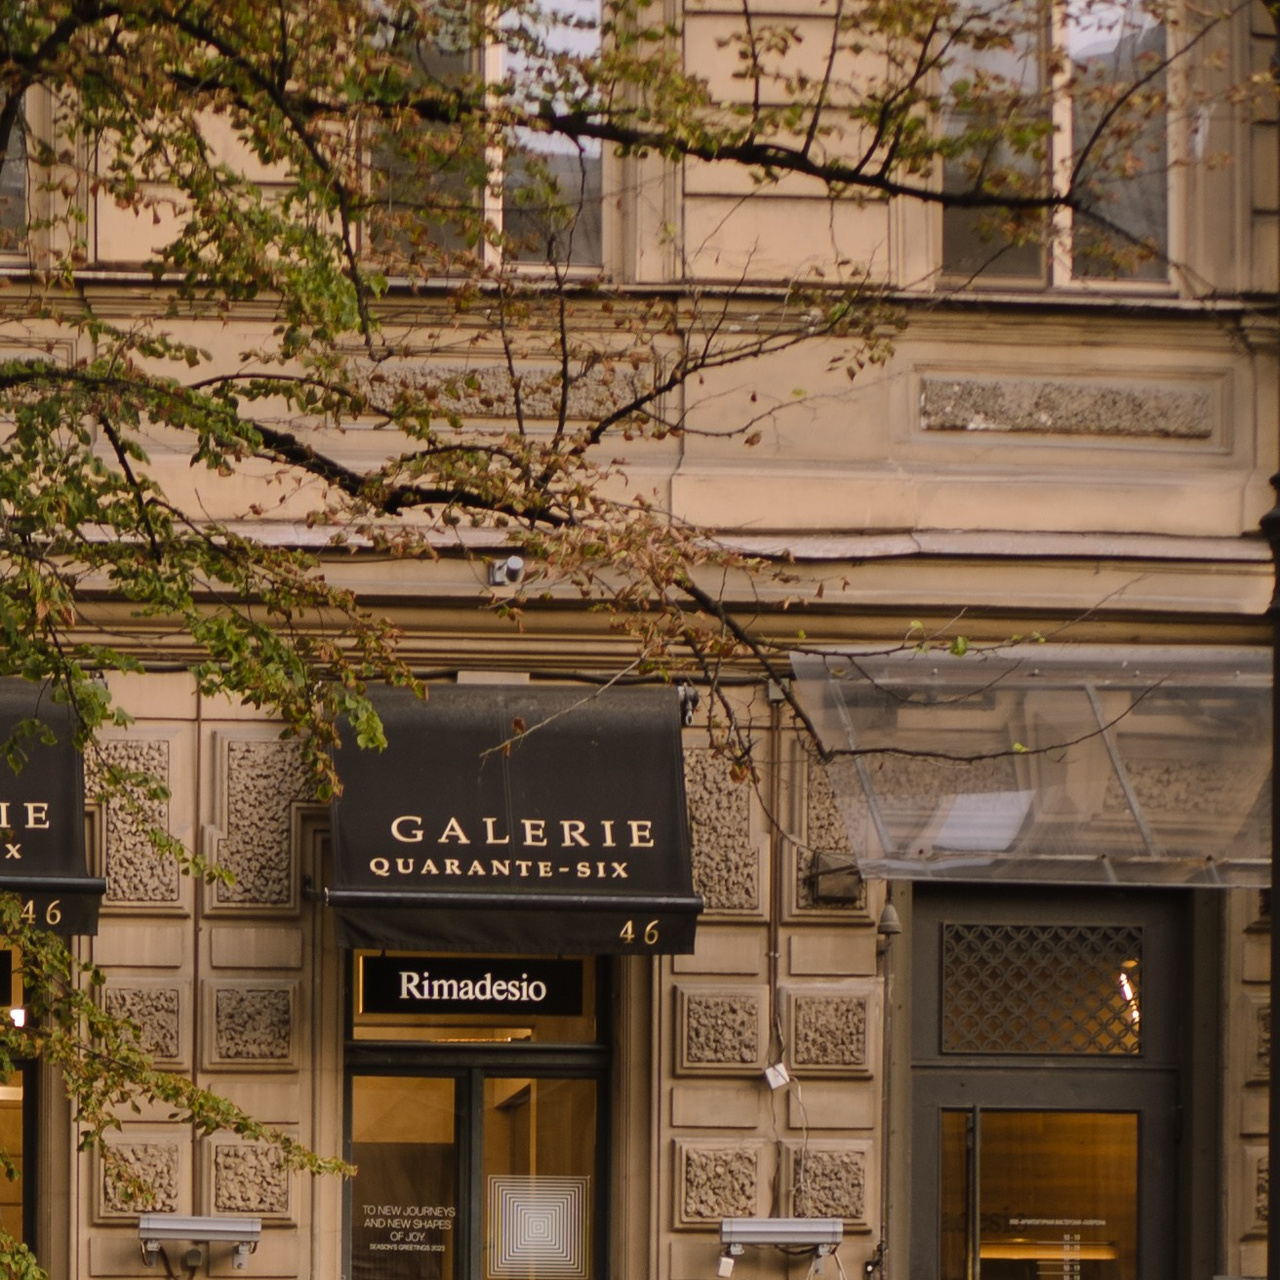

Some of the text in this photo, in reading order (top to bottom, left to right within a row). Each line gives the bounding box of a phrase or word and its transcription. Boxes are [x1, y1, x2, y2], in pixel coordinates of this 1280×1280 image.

[390, 815, 655, 848] GALERIE
[369, 857, 629, 879] QUARANTE-SIX
[20, 899, 62, 926] 46
[619, 919, 660, 945] 46
[399, 971, 547, 1001] Rimadesio
[362, 1204, 456, 1217] TO NEW JOURNEYS
[363, 1218, 452, 1230] AND NEW SHAPES
[389, 1231, 404, 1242] OF
